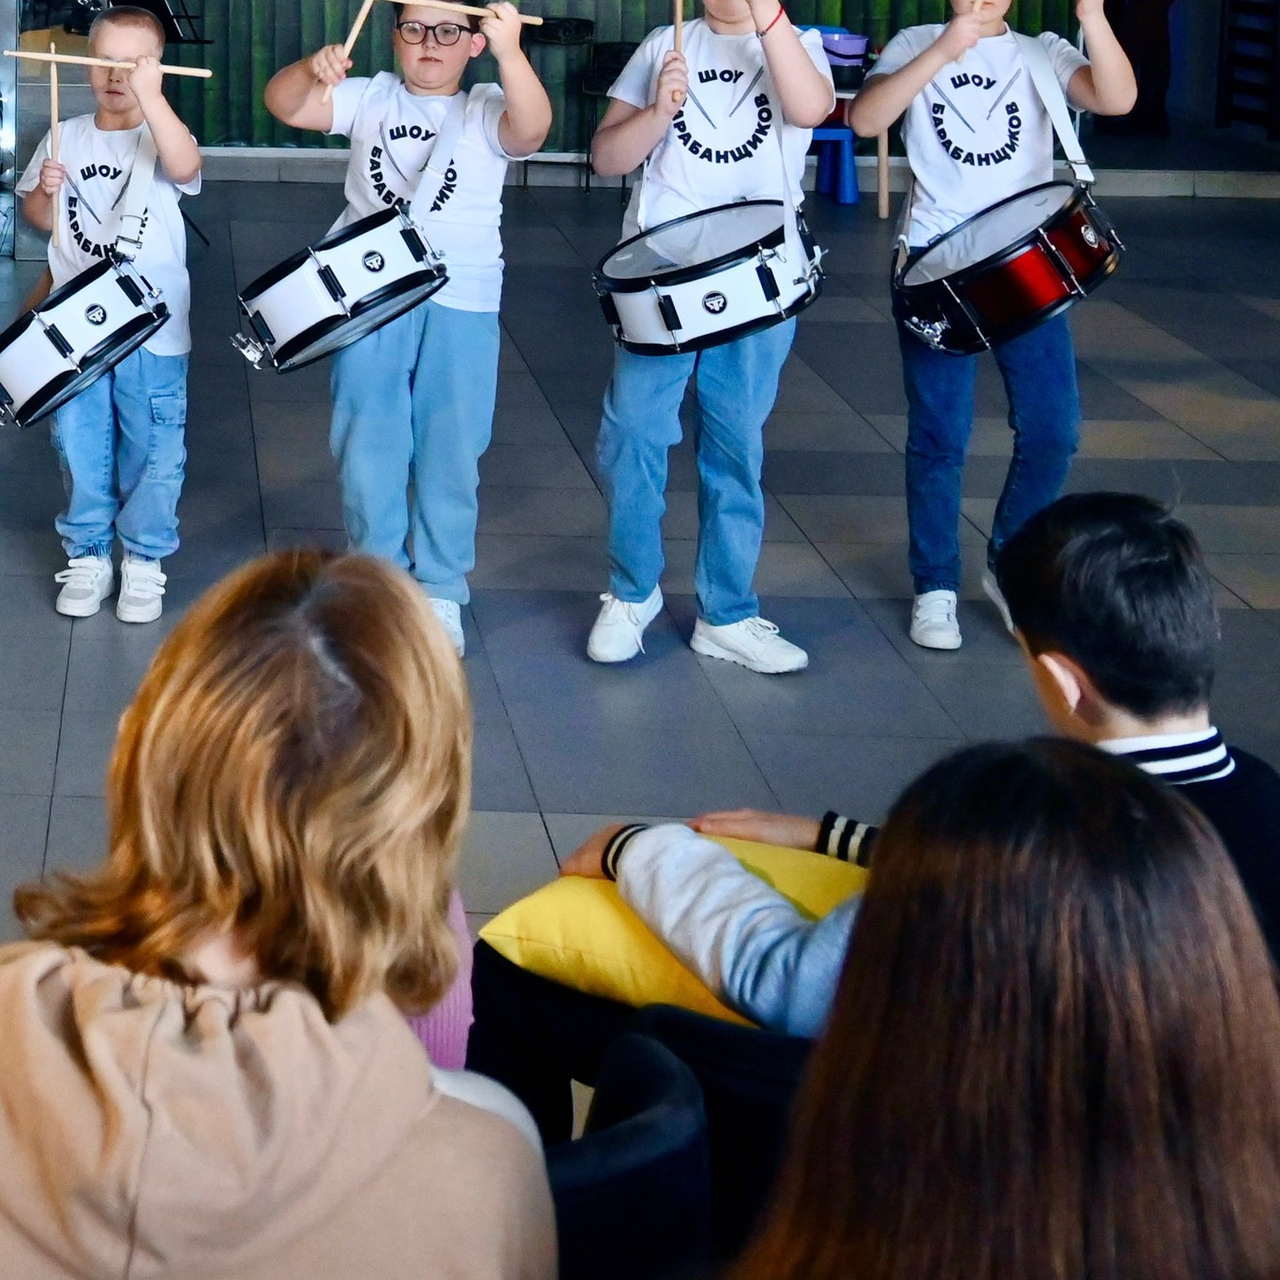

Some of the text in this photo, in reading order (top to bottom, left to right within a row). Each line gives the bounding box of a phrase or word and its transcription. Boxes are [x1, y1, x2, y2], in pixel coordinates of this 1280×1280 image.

[697, 69, 744, 84] ШОУ
[950, 72, 997, 90] ШОУ
[389, 124, 437, 141] ШОУ
[671, 92, 773, 164] АРАБАНЩИКОВ
[931, 101, 1022, 167] БАРАБАНЩИКОВ
[79, 163, 122, 181] ШОУ
